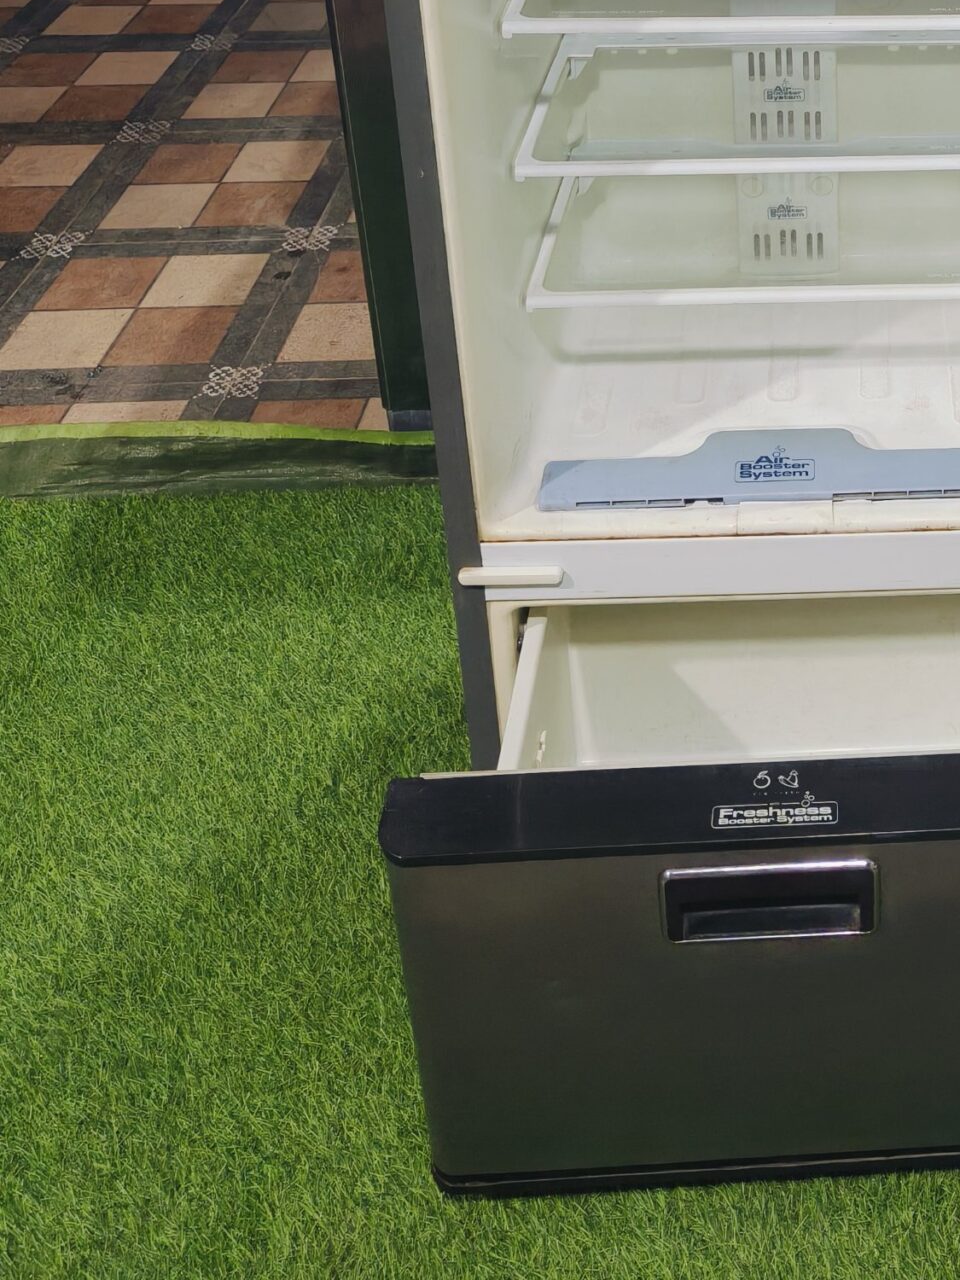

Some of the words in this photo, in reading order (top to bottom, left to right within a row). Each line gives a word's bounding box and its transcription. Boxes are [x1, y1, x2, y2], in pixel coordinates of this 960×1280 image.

[754, 455, 791, 464] Air
[740, 463, 810, 471] Booster
[739, 470, 809, 480] System
[719, 806, 833, 819] Freshness
[718, 817, 775, 826] Booster
[776, 814, 833, 825] System
